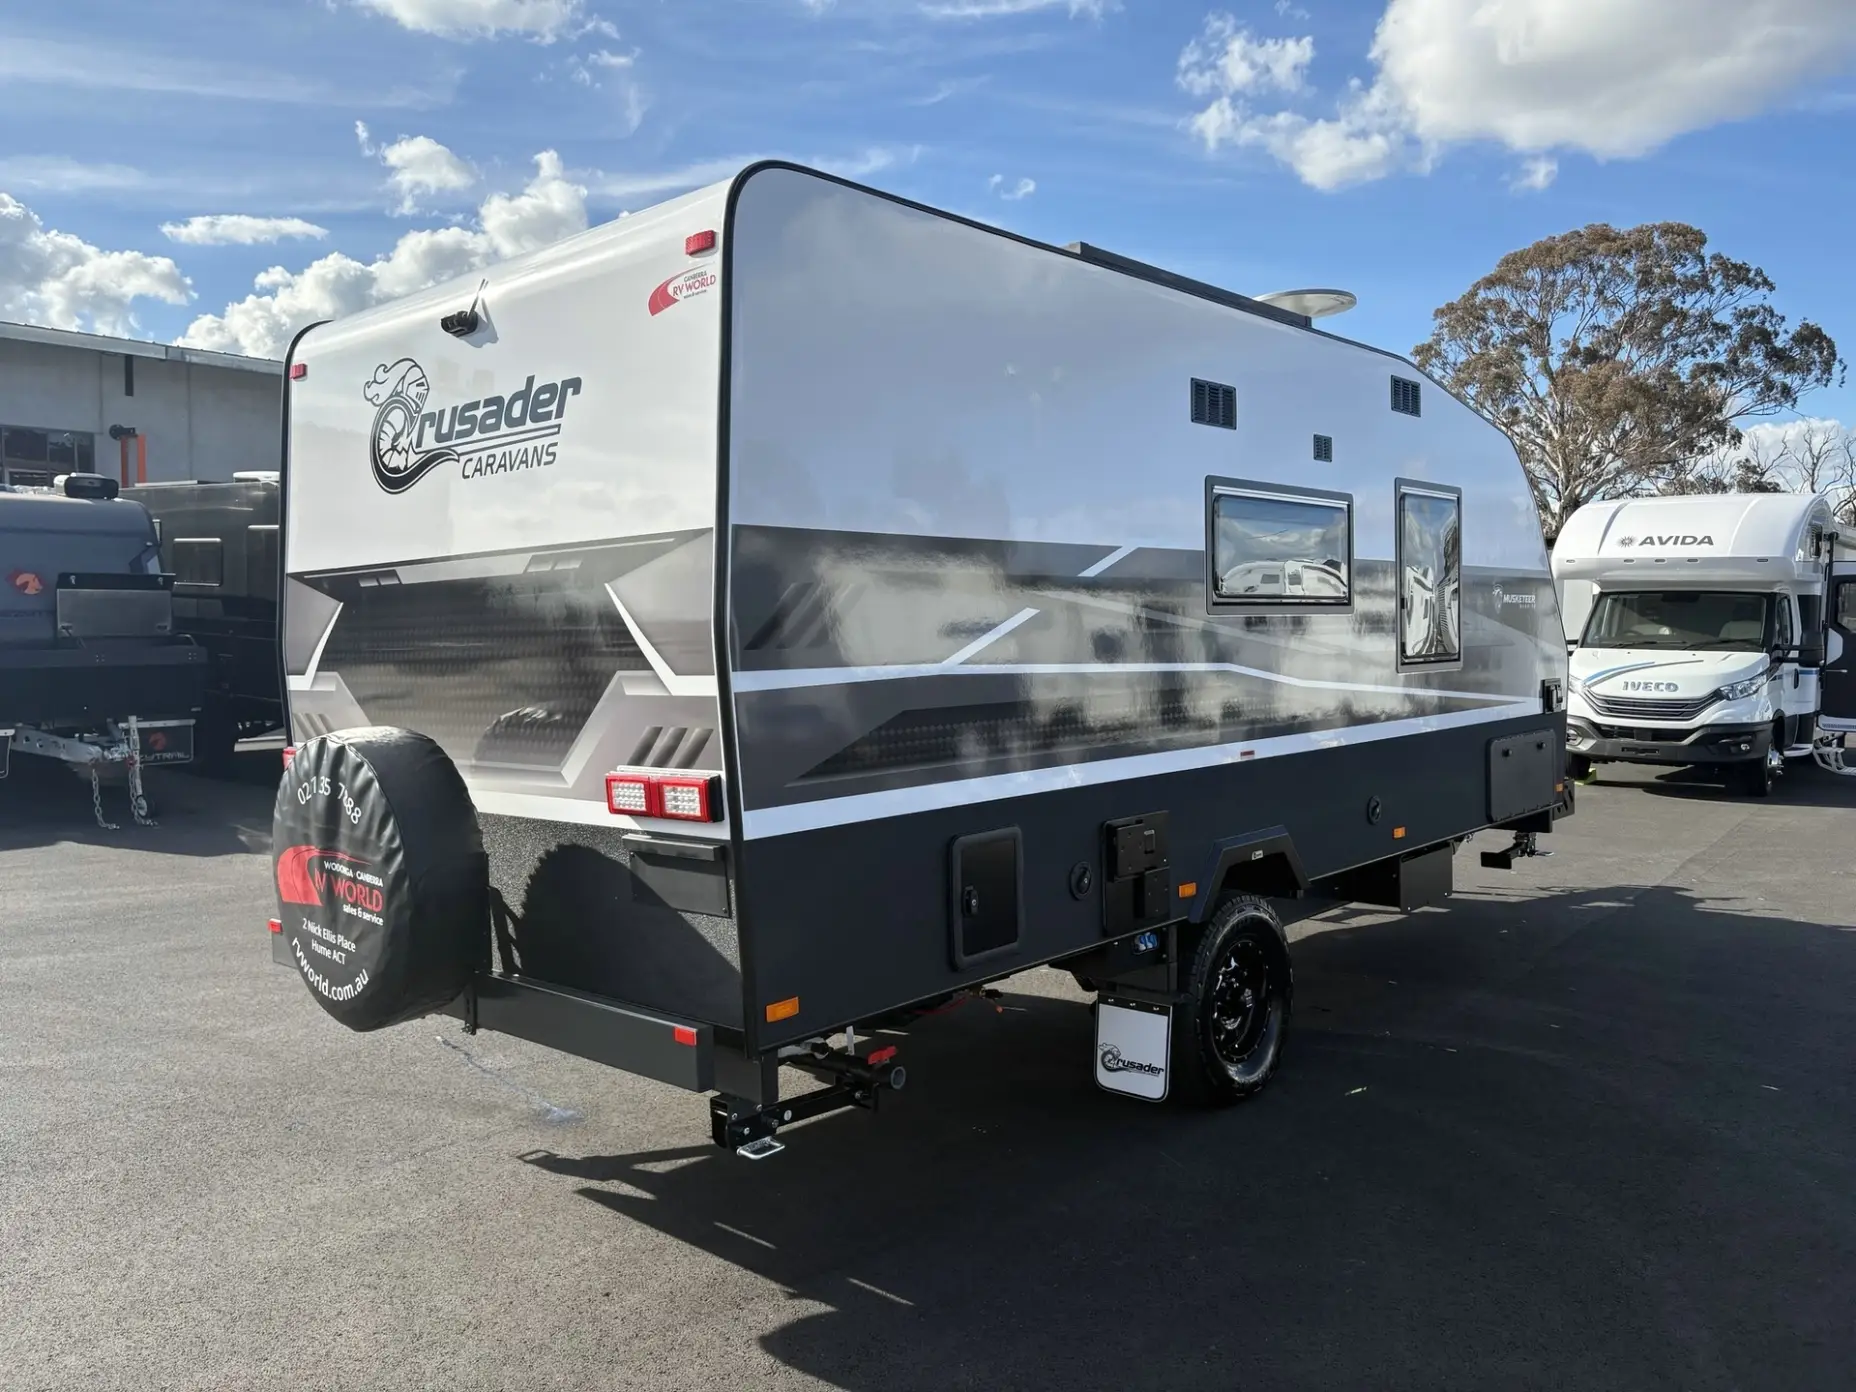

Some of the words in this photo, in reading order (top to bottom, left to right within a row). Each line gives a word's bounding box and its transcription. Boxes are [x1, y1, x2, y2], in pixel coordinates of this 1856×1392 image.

[672, 284, 684, 297] RV
[684, 274, 717, 292] WORLD
[370, 374, 582, 494] Crusader
[461, 442, 559, 480] CARAVANS
[1638, 535, 1714, 547] AVIDA
[1622, 681, 1679, 693] IVECO
[329, 872, 384, 913] WORLD
[342, 903, 357, 916] sales
[362, 911, 384, 926] service
[302, 917, 308, 930] 2
[308, 919, 322, 938] Nick
[322, 927, 337, 944] Ellis
[337, 933, 357, 953] Place
[311, 938, 332, 959] Hume
[332, 949, 346, 965] ACT
[1101, 1049, 1165, 1076] Crusader
